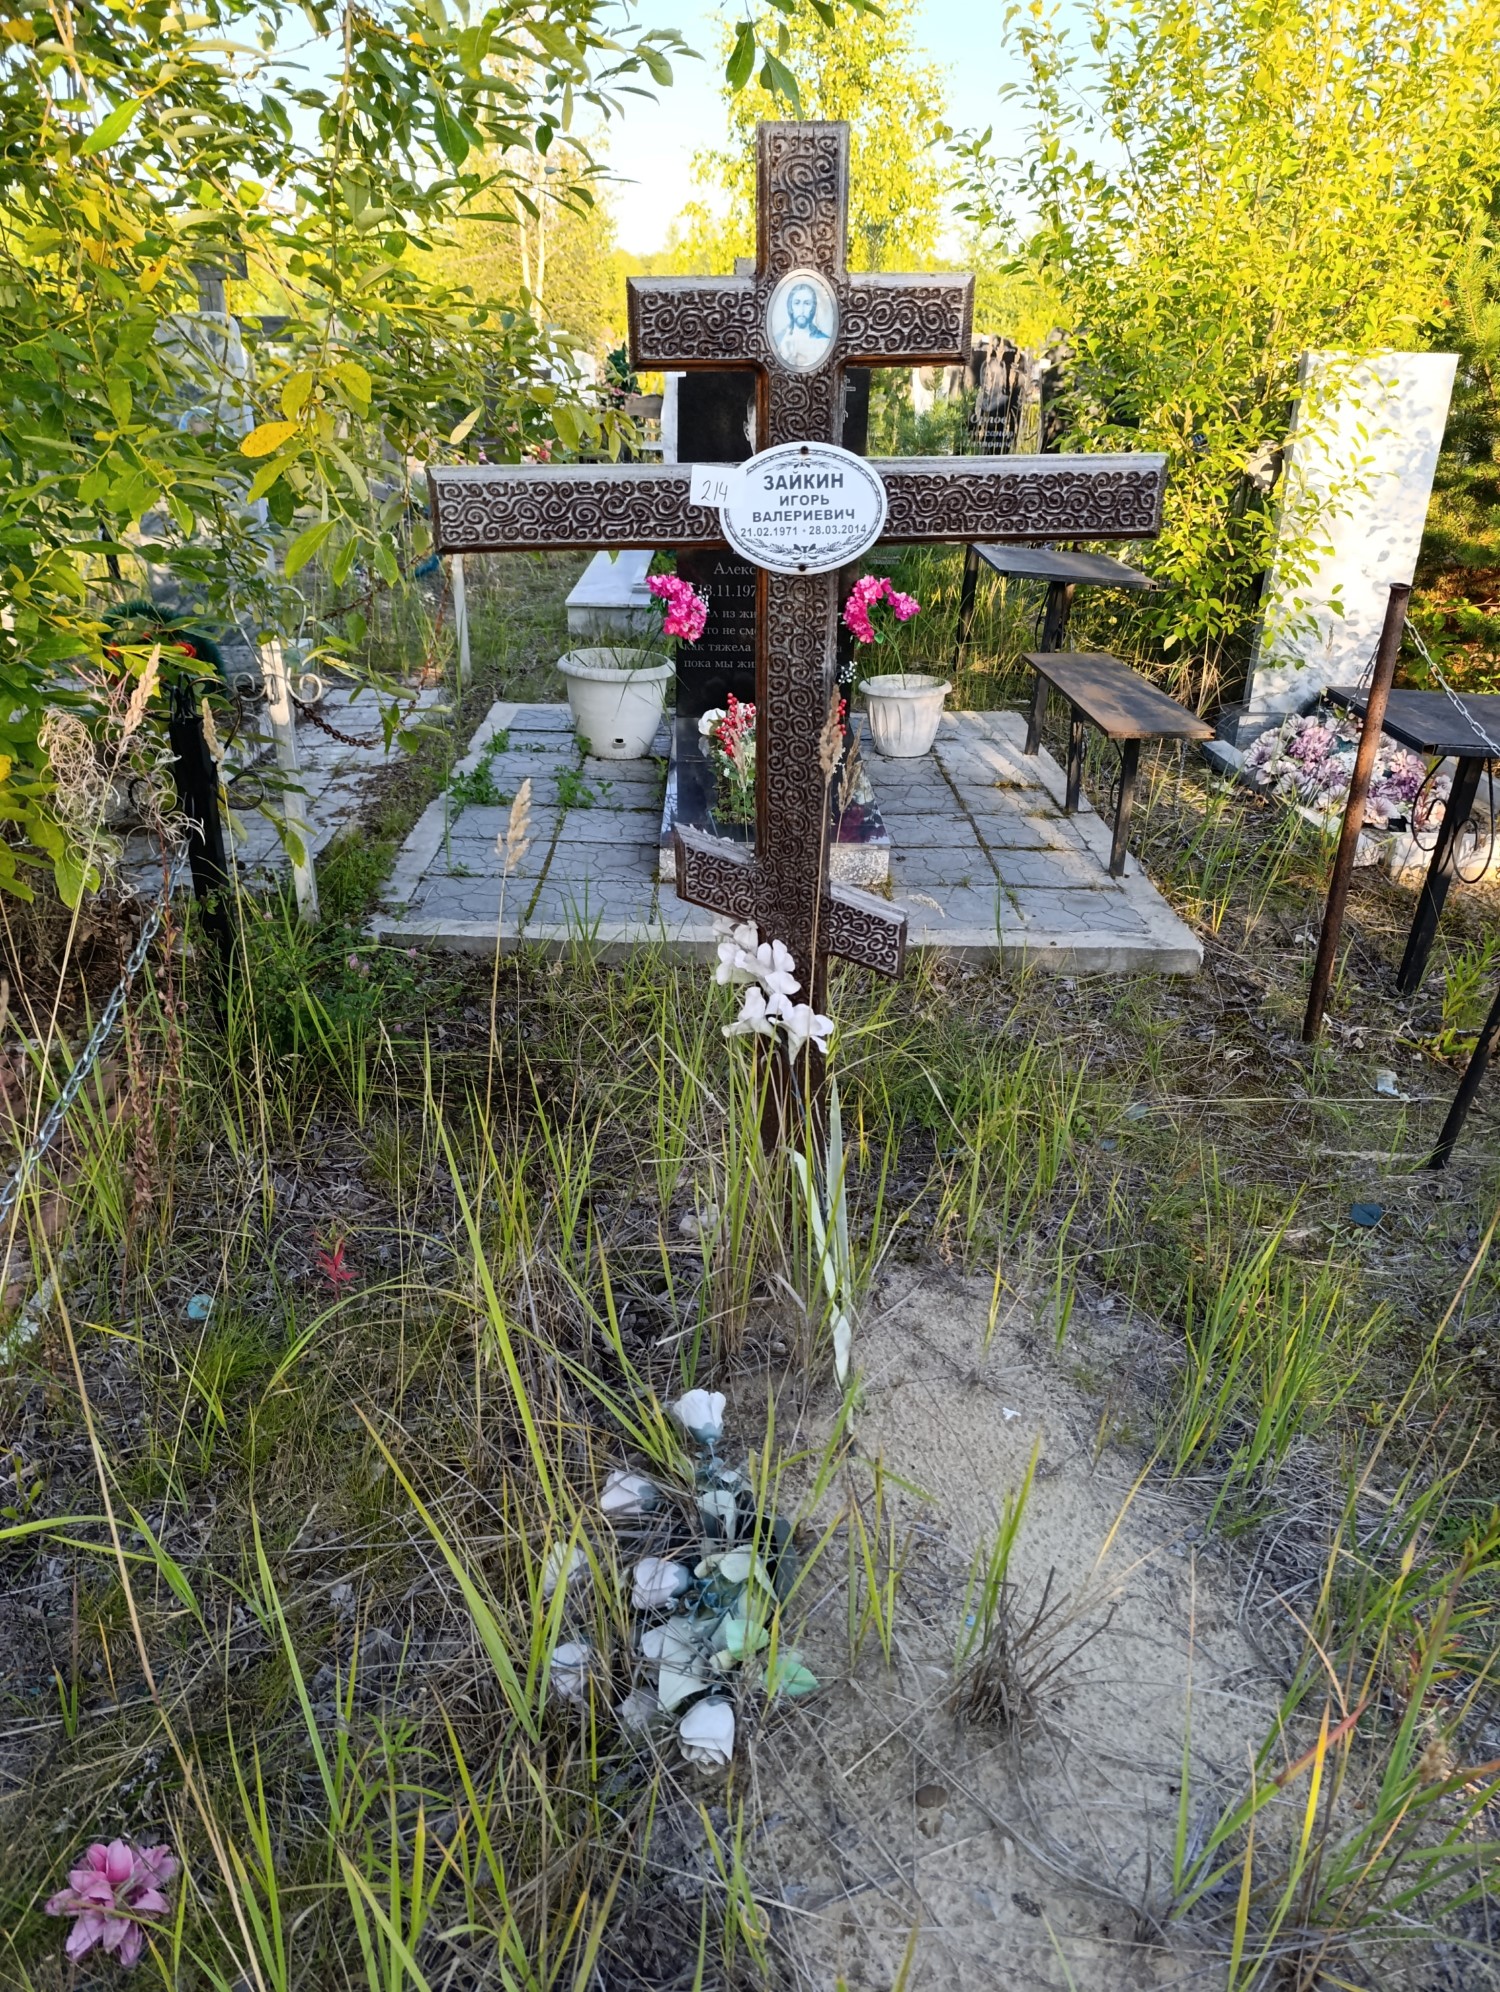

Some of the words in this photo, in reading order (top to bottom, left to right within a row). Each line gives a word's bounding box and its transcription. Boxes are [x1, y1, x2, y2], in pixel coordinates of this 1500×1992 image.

[763, 471, 844, 490] ЗАЙКИН
[700, 480, 728, 502] 214
[779, 495, 830, 506] ИГОРЬ
[752, 509, 856, 523] ВАЛЕРИЕВИЧ
[741, 526, 798, 538] 21.02.1971
[809, 524, 867, 535] 28.03.2014
[722, 627, 736, 635] не
[708, 644, 752, 652] тяжела
